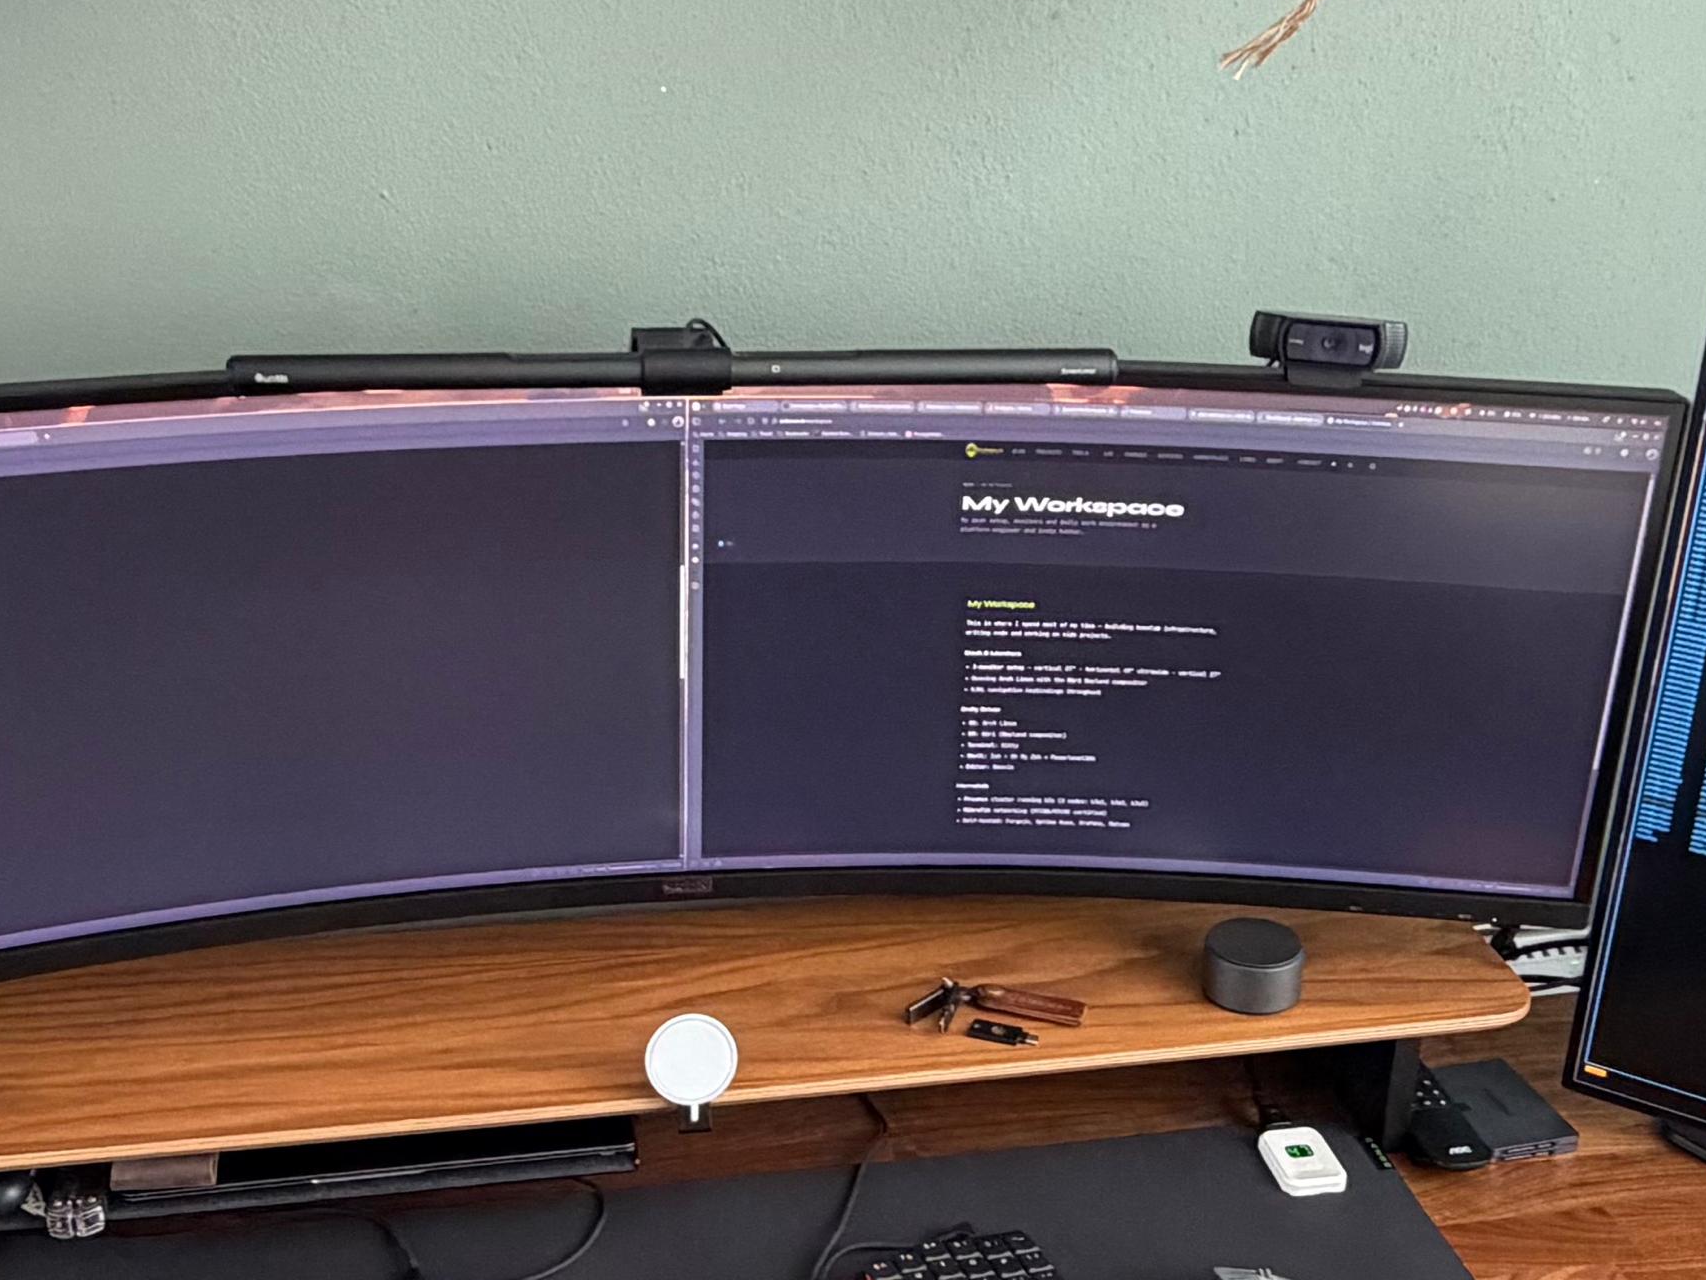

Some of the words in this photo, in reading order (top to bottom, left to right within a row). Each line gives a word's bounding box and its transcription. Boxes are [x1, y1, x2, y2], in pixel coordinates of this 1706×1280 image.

[962, 496, 1009, 515] My
[1014, 496, 1184, 517] Workspace
[967, 600, 981, 610] My
[984, 600, 1035, 609] Workspace
